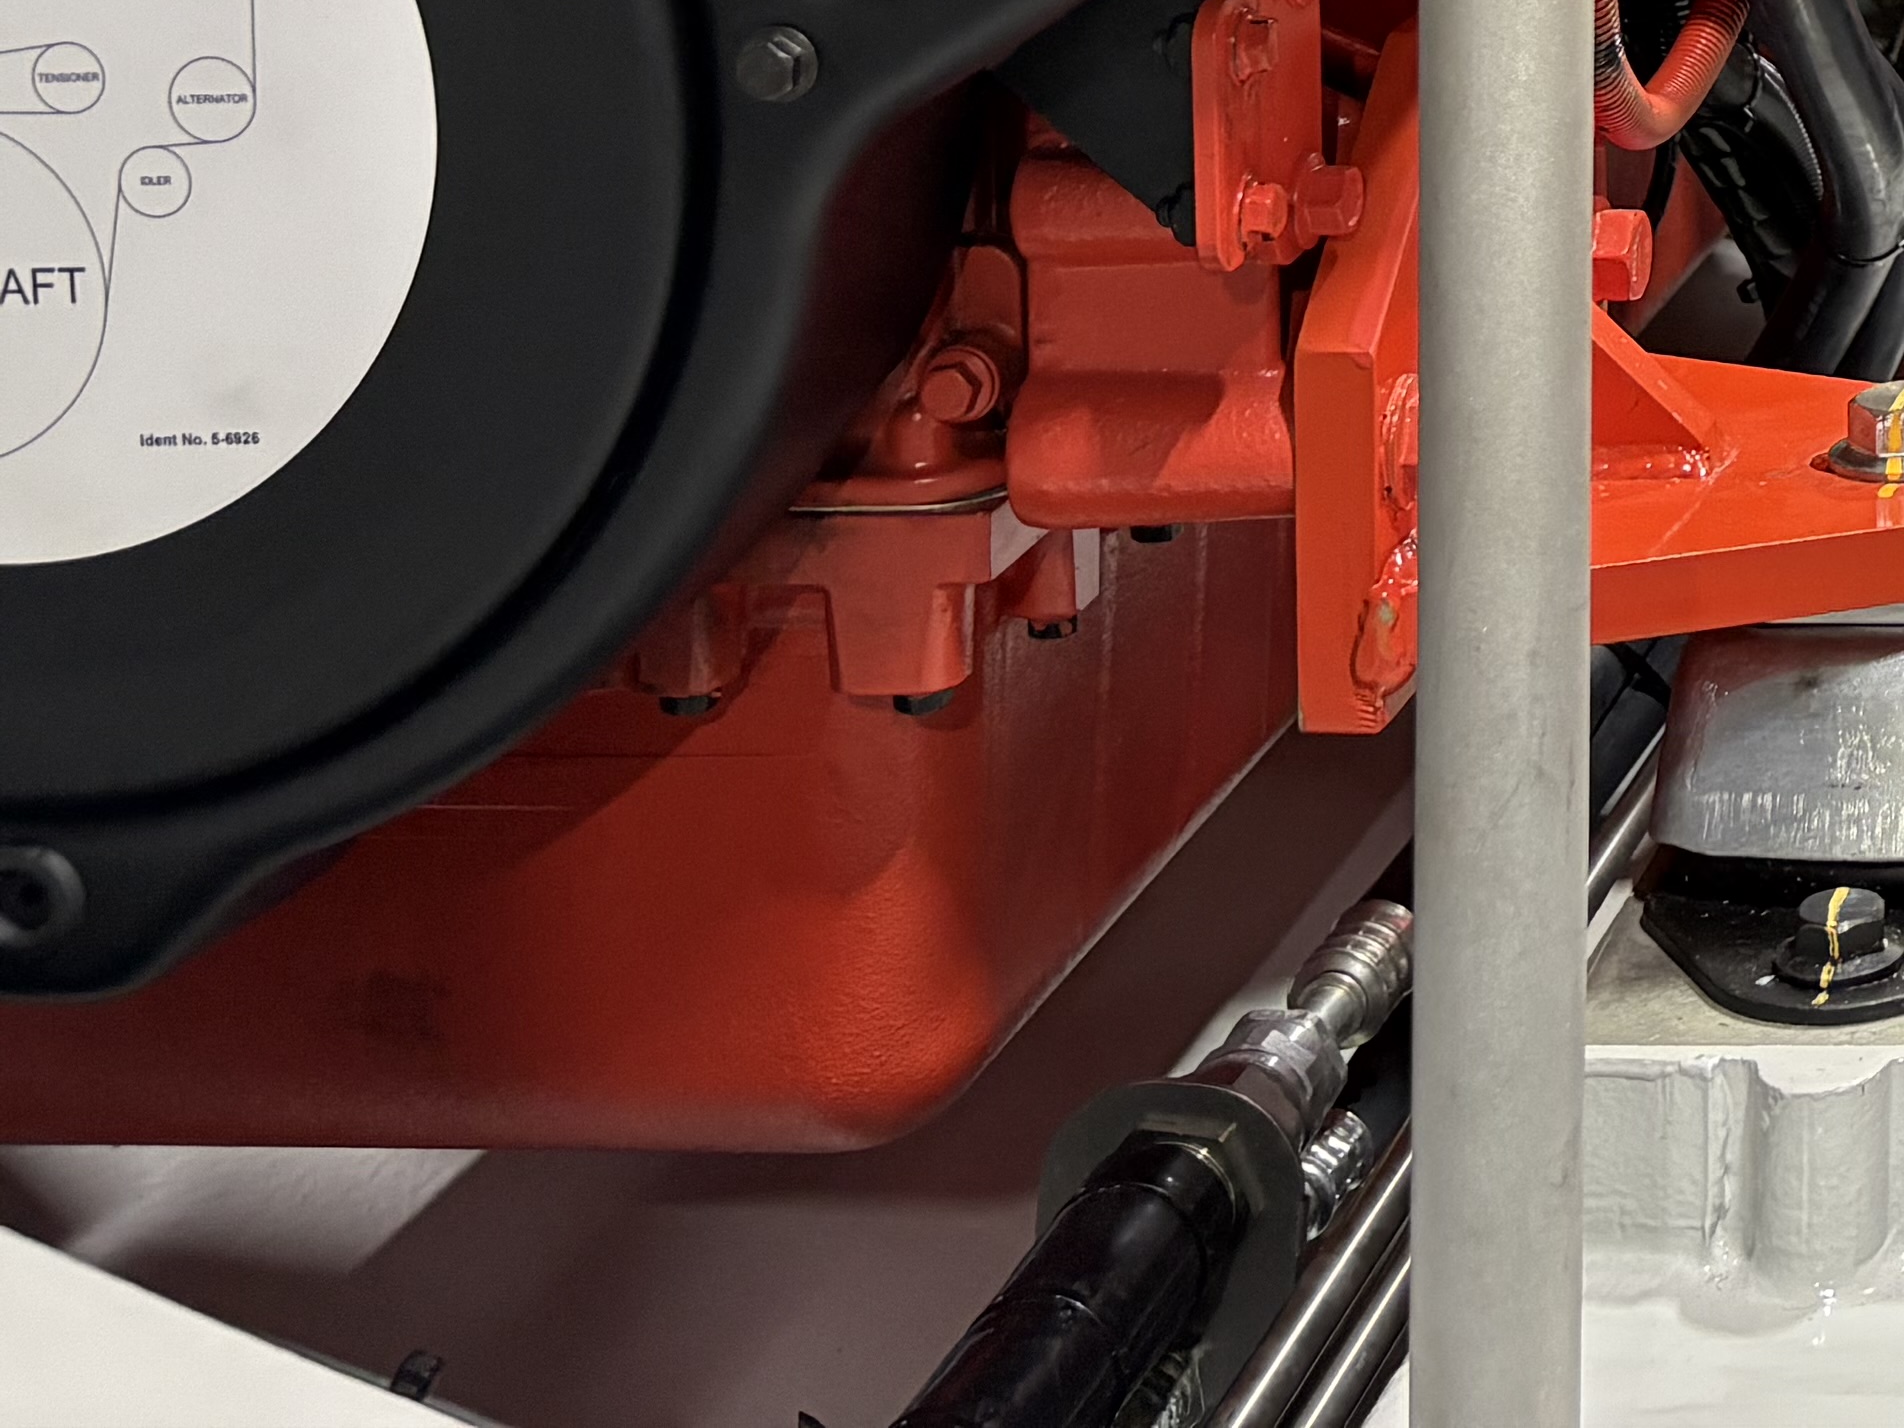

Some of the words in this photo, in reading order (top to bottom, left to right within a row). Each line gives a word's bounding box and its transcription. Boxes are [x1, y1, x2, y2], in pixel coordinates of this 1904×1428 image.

[37, 72, 100, 84] TENSIONER
[176, 93, 248, 105] ALTERNATOR
[140, 175, 172, 186] IDLER
[0, 267, 86, 305] AFT
[140, 433, 178, 447] Ident
[181, 433, 207, 446] No.
